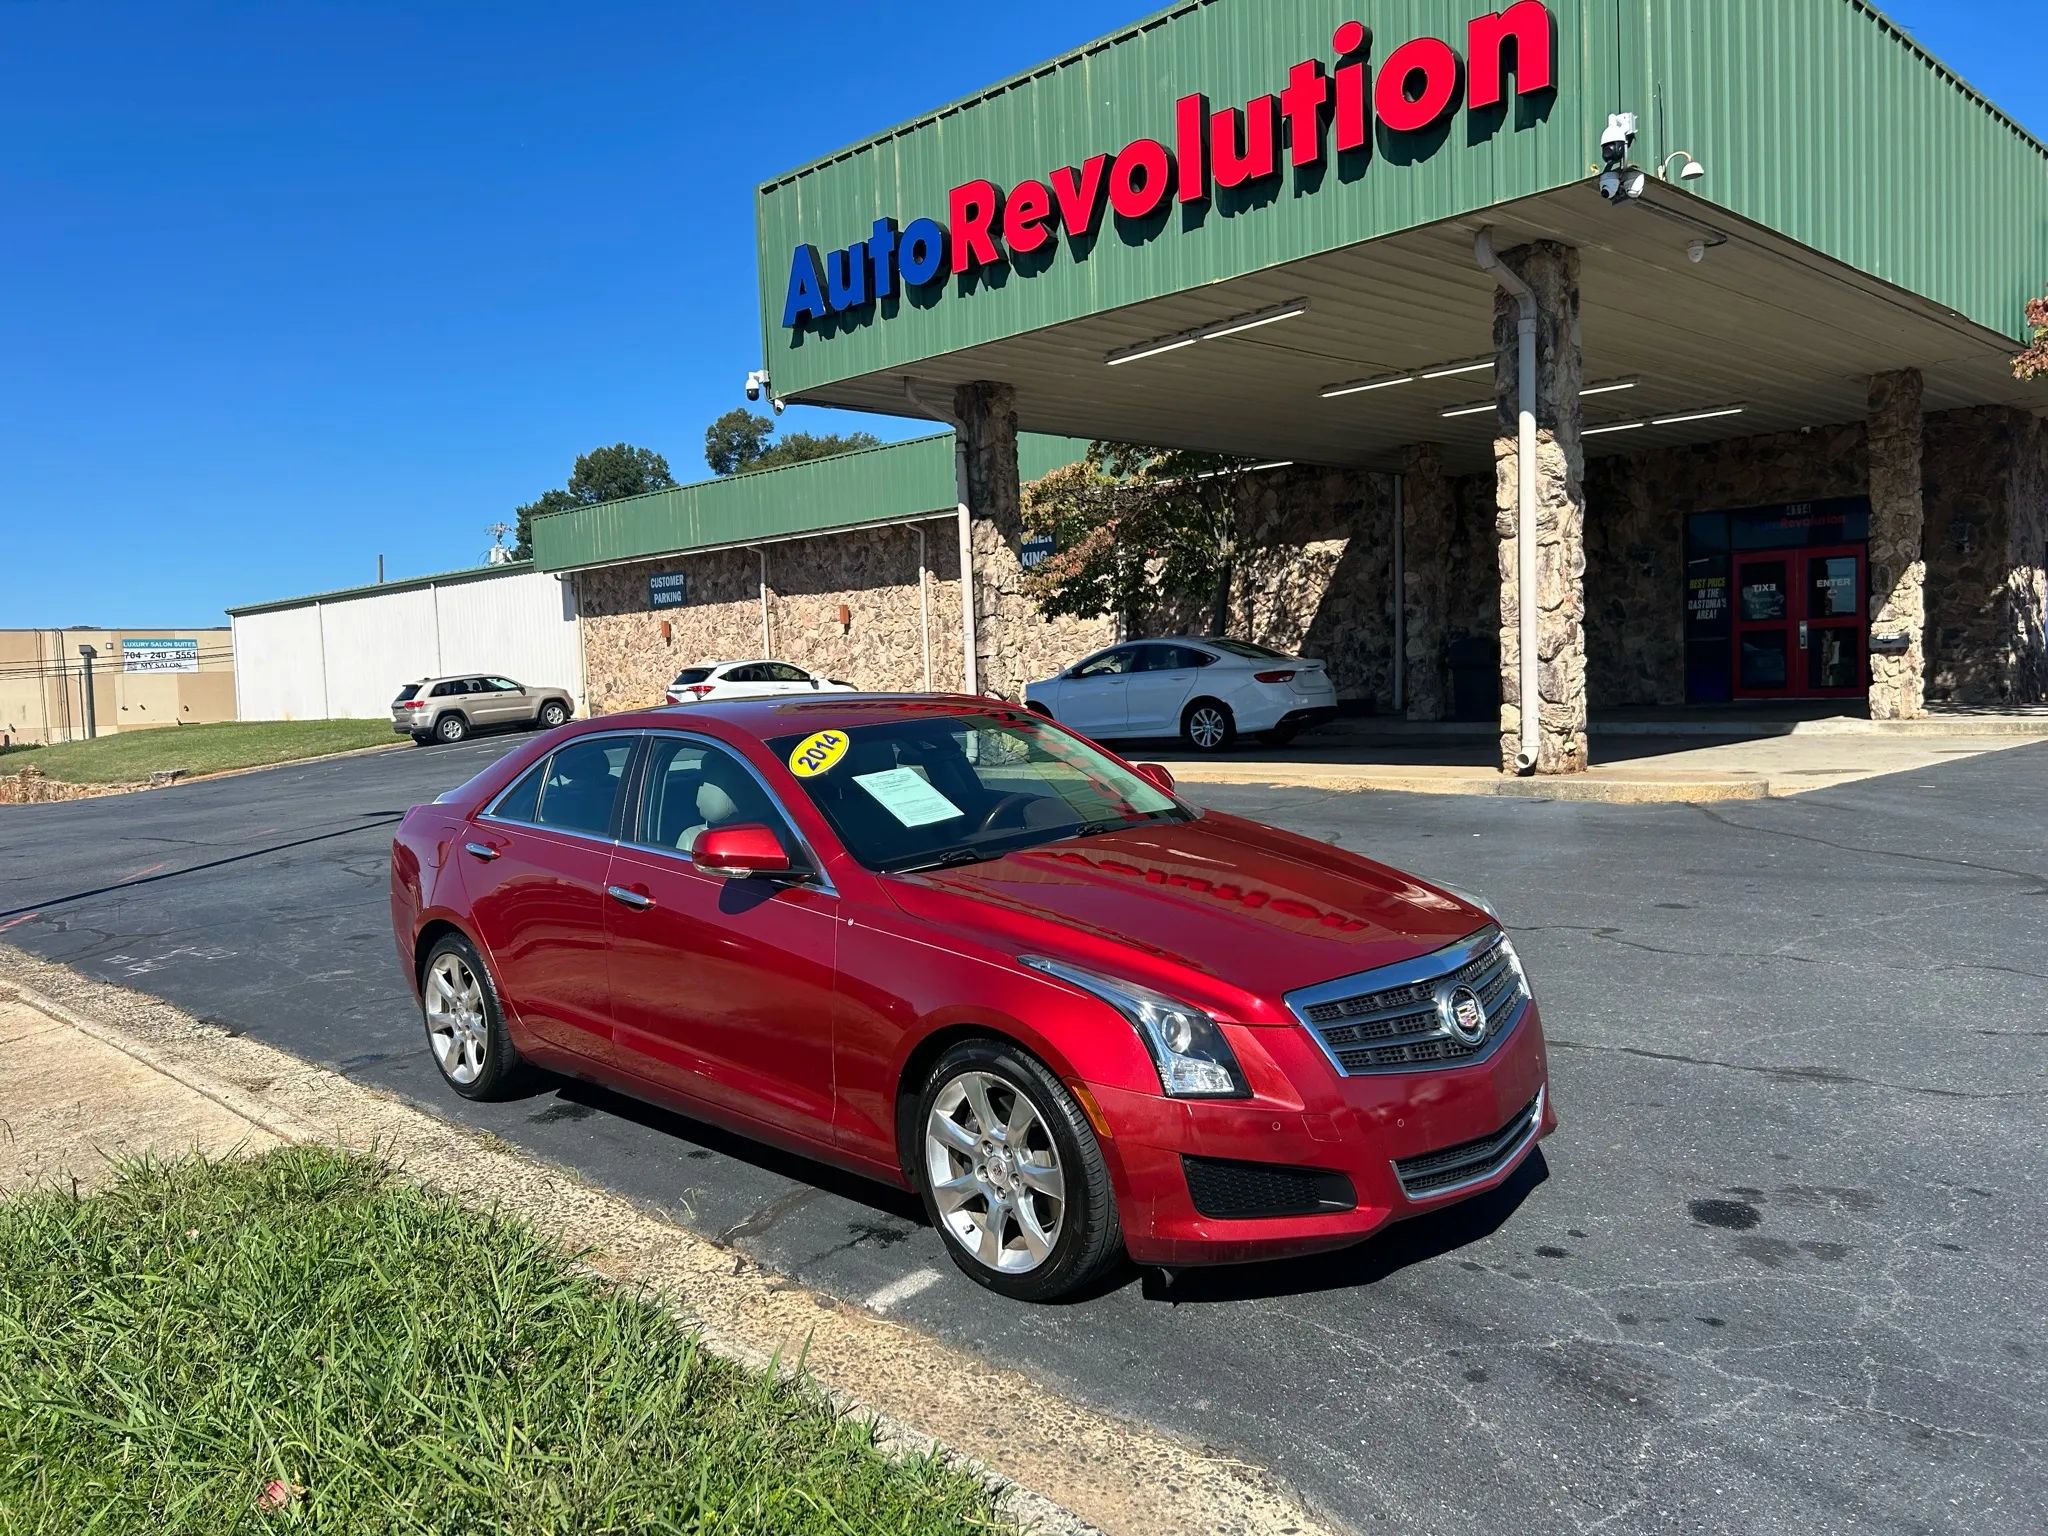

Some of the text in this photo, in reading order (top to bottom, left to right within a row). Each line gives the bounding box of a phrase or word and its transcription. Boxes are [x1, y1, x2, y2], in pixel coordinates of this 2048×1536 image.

[782, 0, 1552, 328] AutoRevolution
[650, 574, 684, 588] CUSTOMER
[1816, 578, 1851, 588] ENTER
[653, 591, 682, 605] PARKING
[1707, 587, 1720, 598] THE
[124, 651, 141, 659] 704
[150, 651, 167, 659] 240
[175, 651, 196, 659] 5551
[797, 732, 842, 772] 2014
